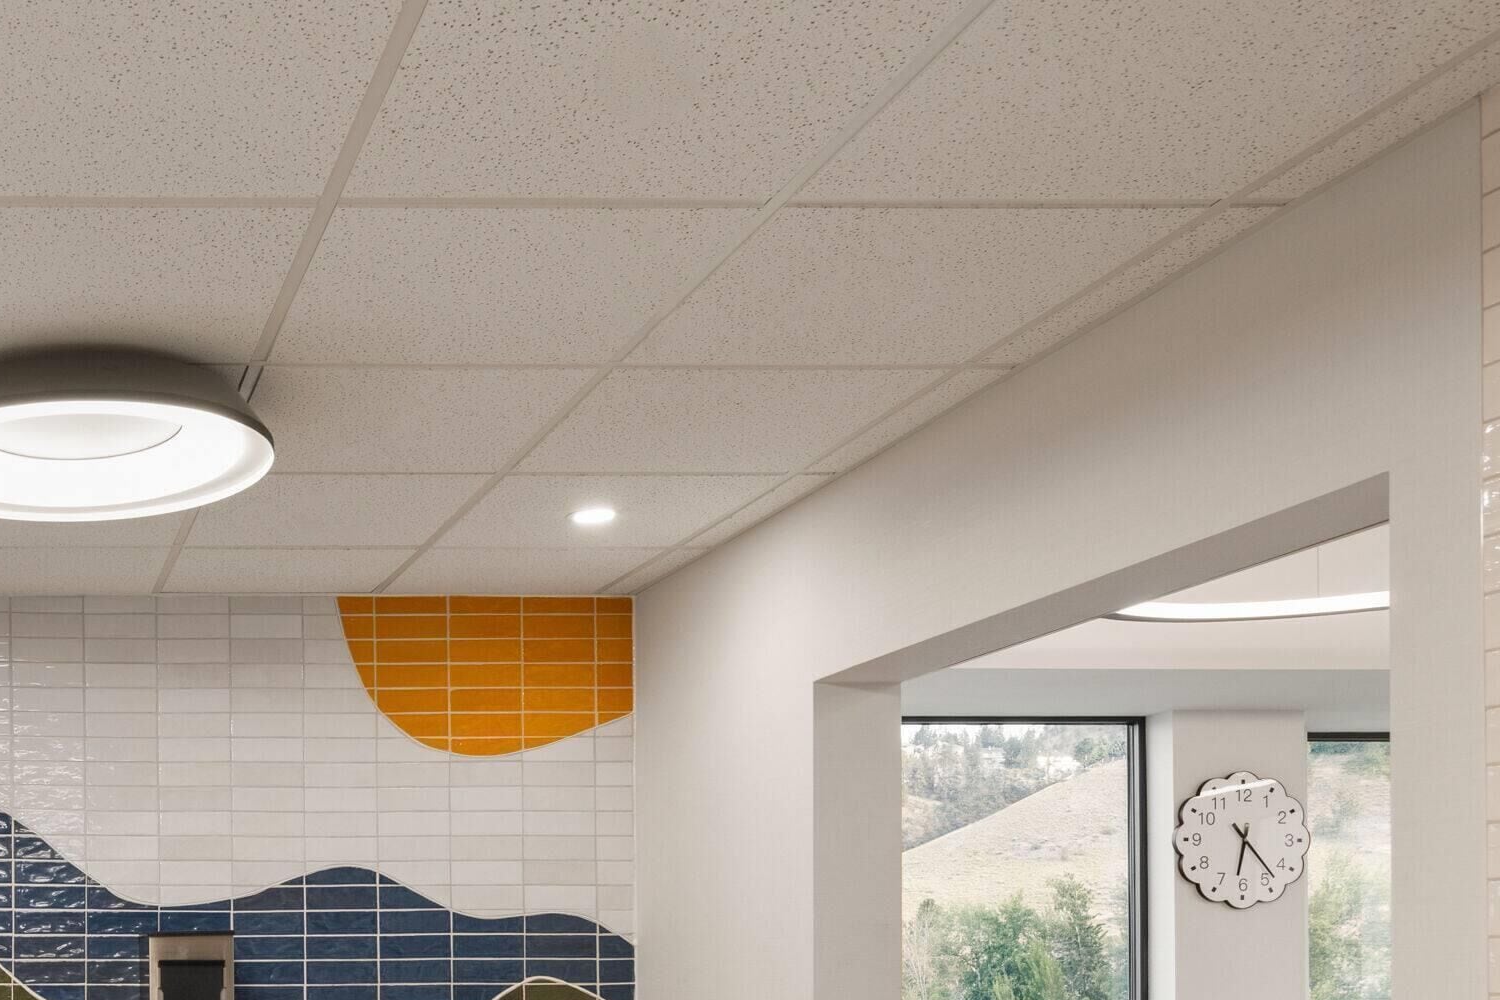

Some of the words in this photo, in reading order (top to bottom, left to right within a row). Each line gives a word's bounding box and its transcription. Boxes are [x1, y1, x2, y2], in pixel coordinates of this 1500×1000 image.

[1236, 789, 1252, 802] 12
[1212, 797, 1226, 810] 11
[1198, 812, 1215, 825] 10
[1278, 811, 1287, 824] 2
[1192, 833, 1202, 846] 9
[1285, 834, 1294, 847] 3
[1199, 856, 1209, 869] 8
[1276, 858, 1286, 870] 4
[1217, 872, 1226, 885] 7
[1238, 878, 1248, 891] 6
[1260, 873, 1270, 886] 5
